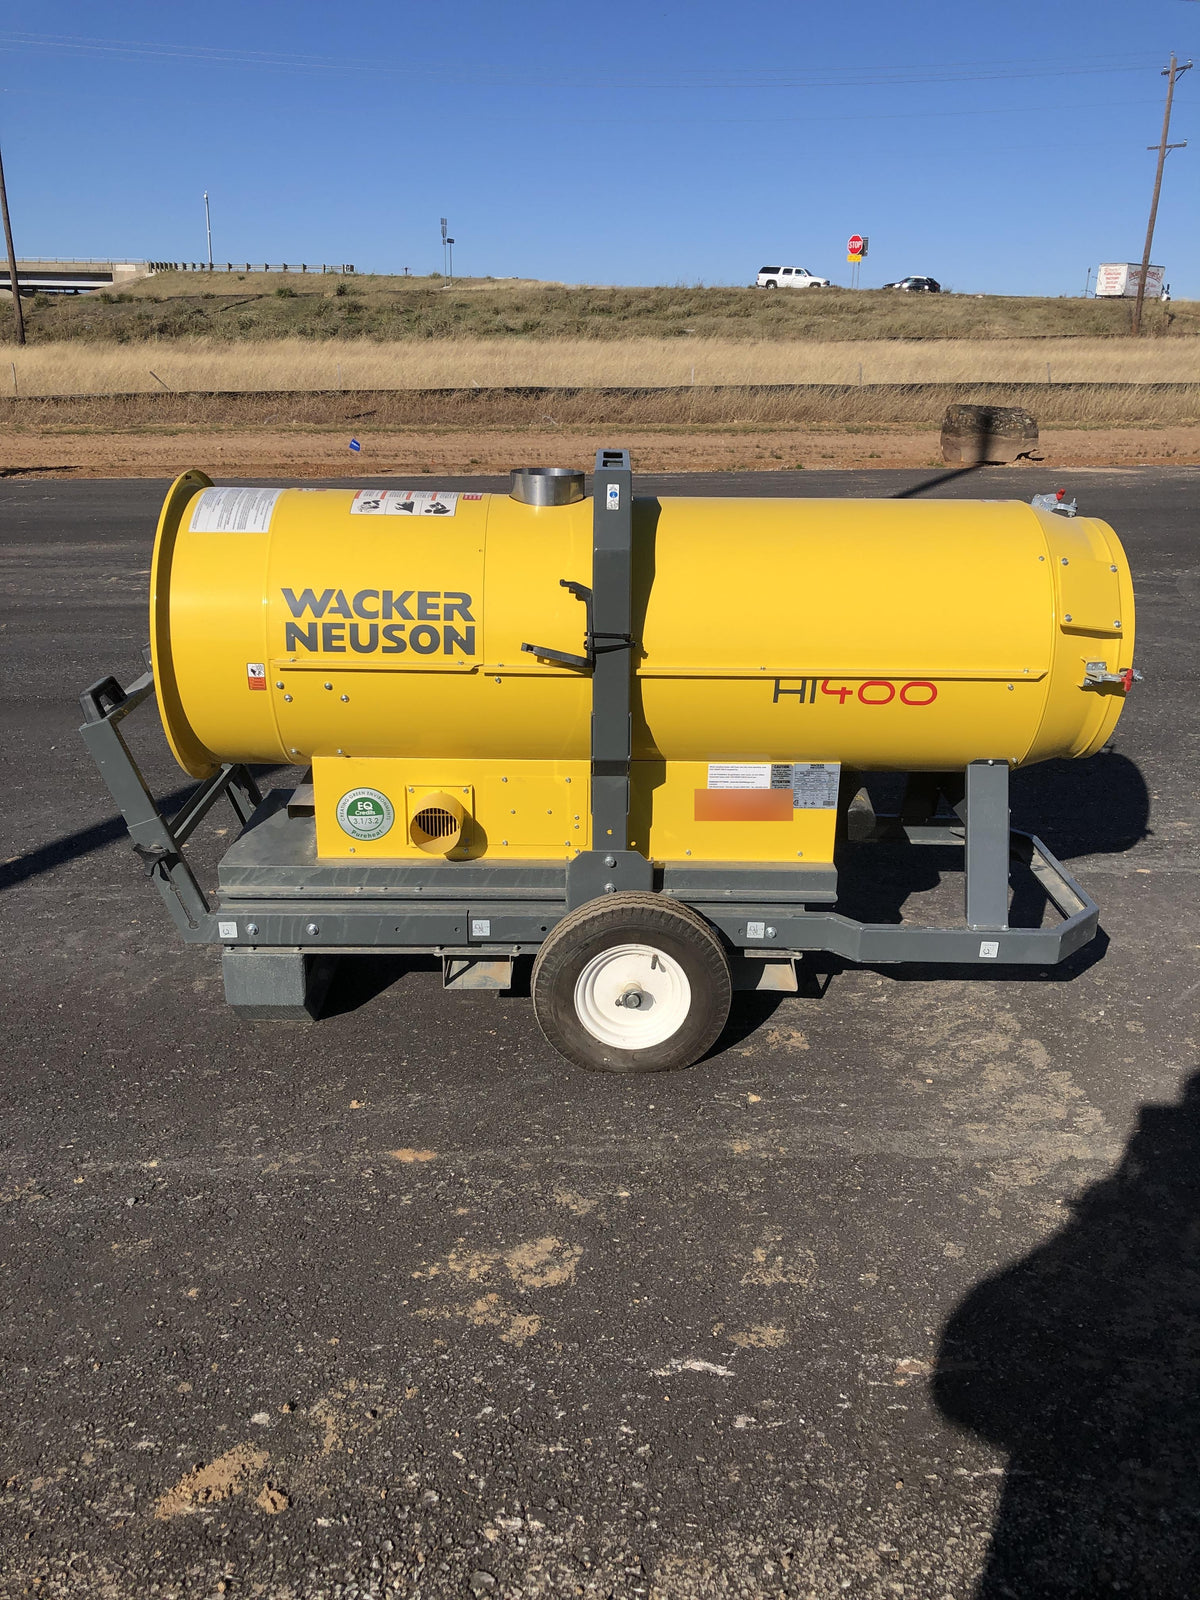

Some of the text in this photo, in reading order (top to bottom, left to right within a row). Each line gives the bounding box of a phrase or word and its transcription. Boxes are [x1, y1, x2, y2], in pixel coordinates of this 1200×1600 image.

[849, 241, 862, 249] STOP
[281, 588, 476, 622] WACKER
[285, 622, 476, 655] NEUSON
[340, 798, 349, 821] CREATING
[348, 791, 366, 799] GREEN
[357, 802, 373, 810] EQ
[353, 817, 379, 825] 3.1/3.2
[351, 829, 383, 838] Pureheat
